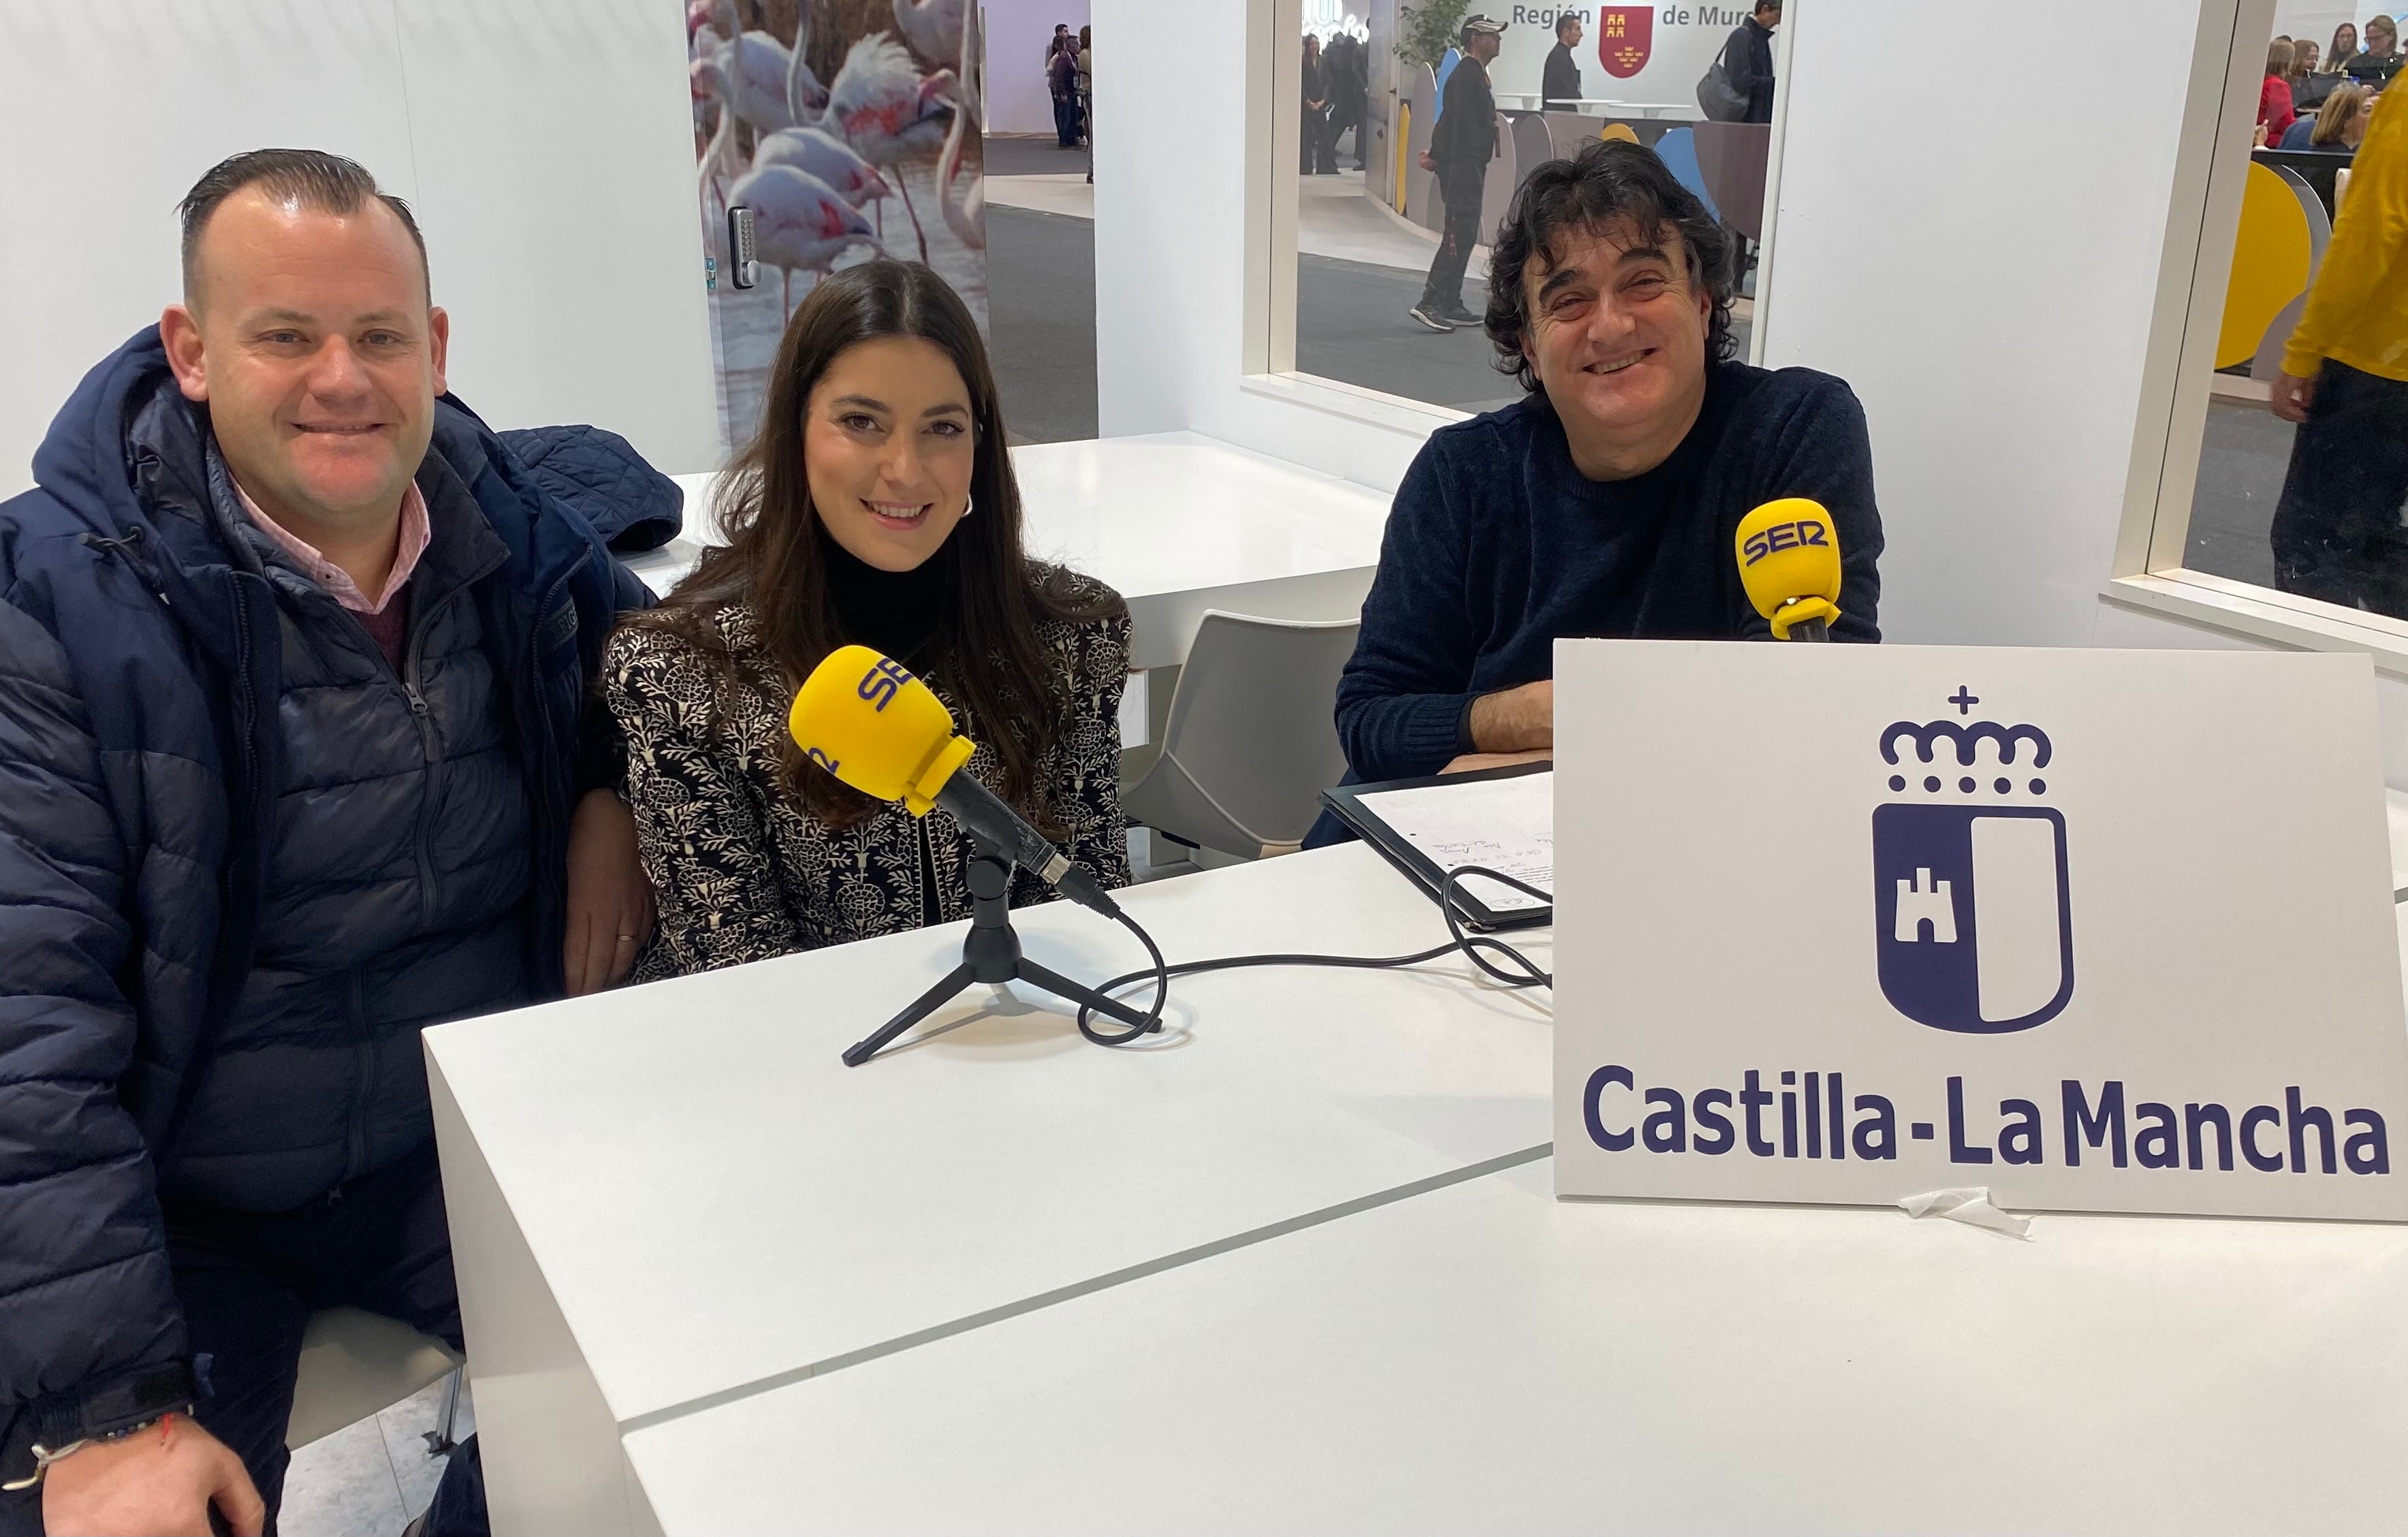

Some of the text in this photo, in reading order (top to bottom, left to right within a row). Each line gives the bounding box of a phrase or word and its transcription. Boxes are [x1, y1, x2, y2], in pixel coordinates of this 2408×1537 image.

[1663, 5, 1690, 25] de
[1743, 521, 1829, 567] SER
[857, 657, 914, 712] SE
[2061, 1079, 2390, 1175] Mancha
